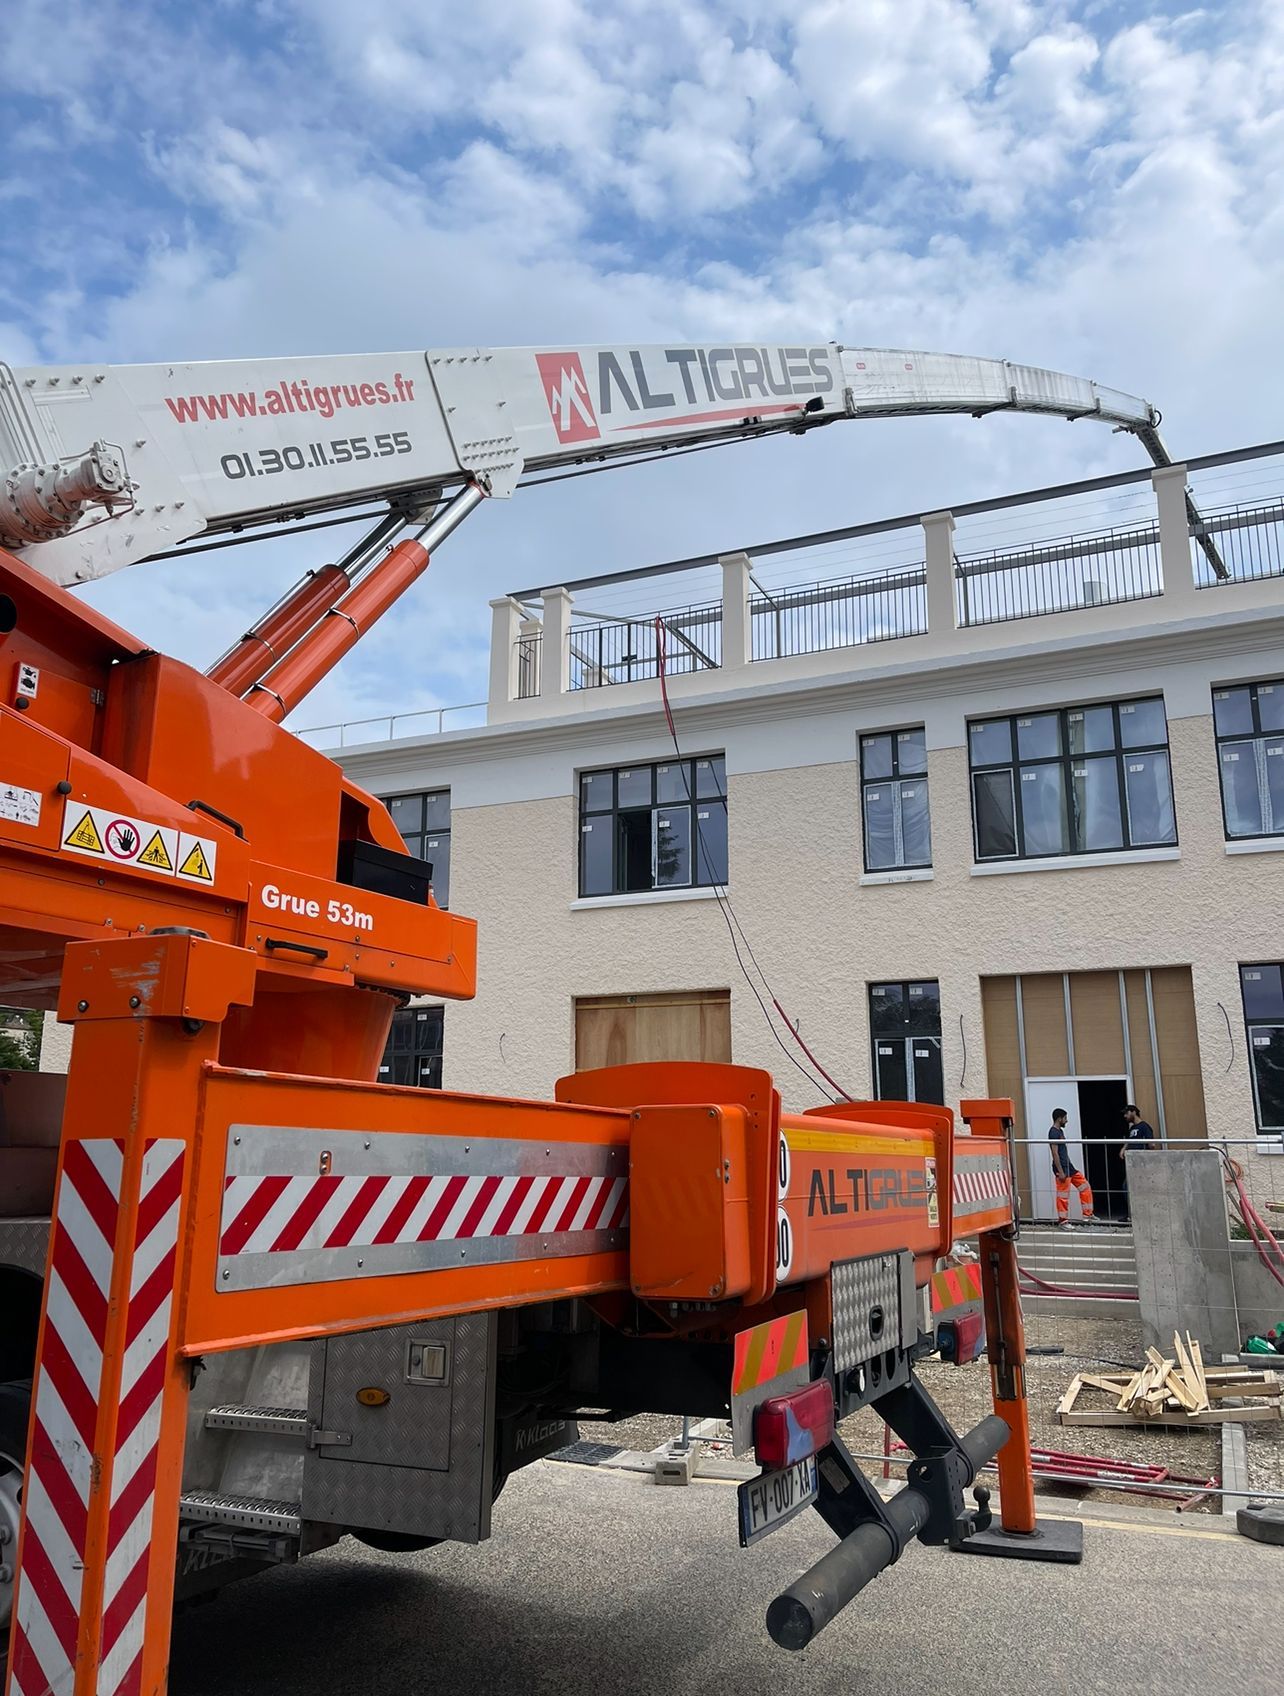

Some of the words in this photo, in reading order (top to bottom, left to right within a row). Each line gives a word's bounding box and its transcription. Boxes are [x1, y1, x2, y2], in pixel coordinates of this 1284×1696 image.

[164, 373, 415, 423] www.altigrues.fr
[598, 347, 833, 414] ALTIGRUES
[221, 432, 412, 480] 01.30.11.55.55
[261, 884, 320, 918] Grue
[327, 900, 374, 931] 53m
[808, 1168, 927, 1217] ALTIGRUE
